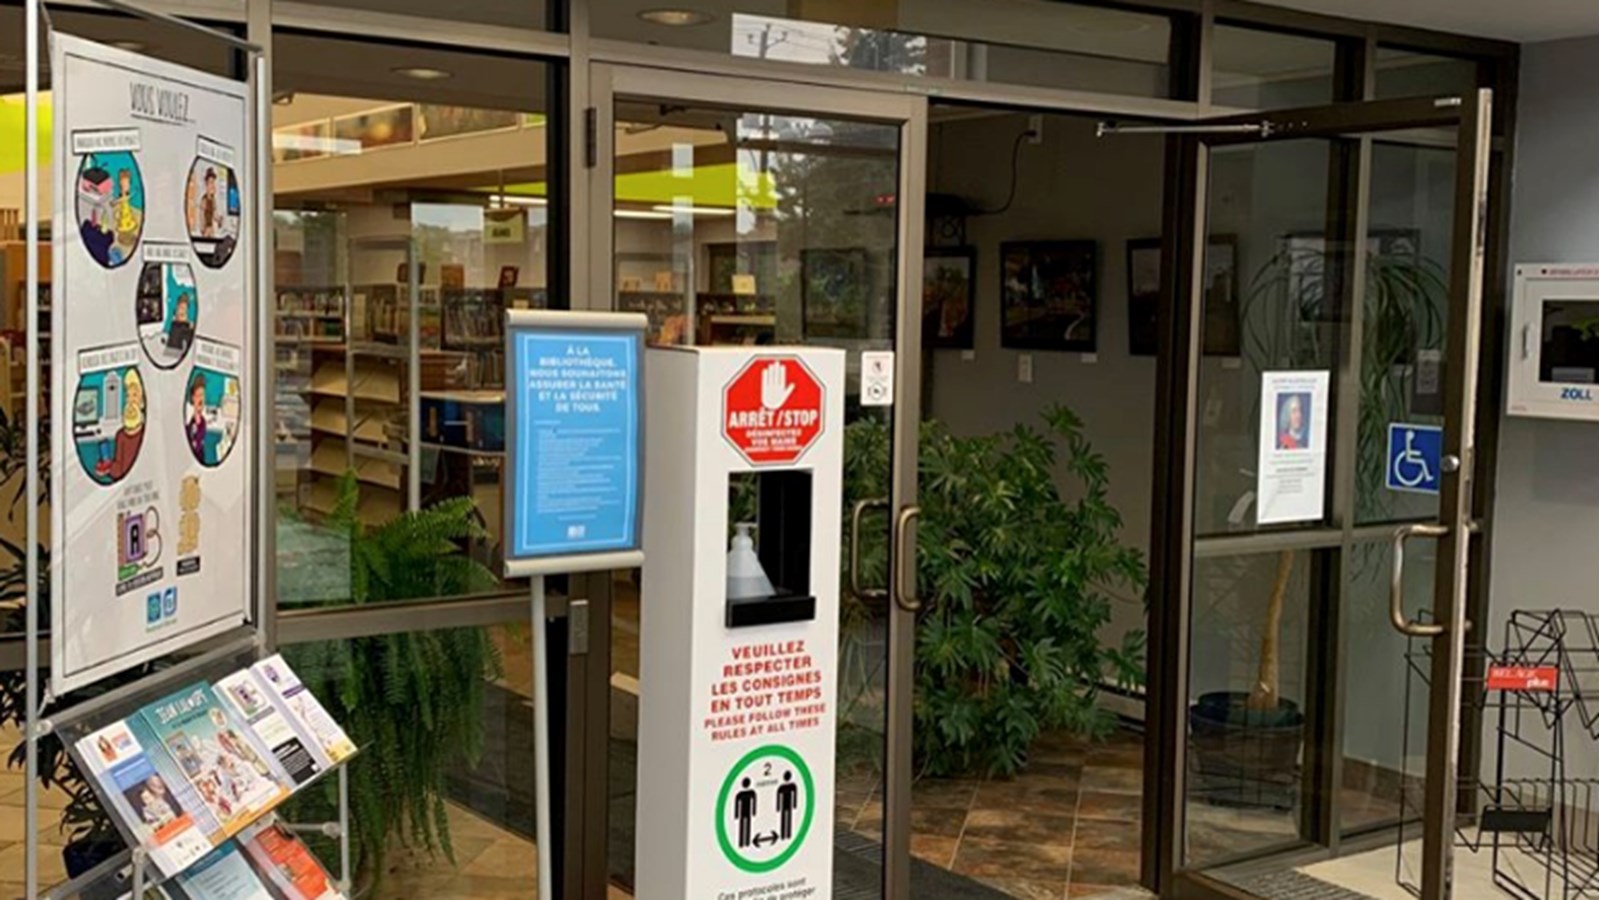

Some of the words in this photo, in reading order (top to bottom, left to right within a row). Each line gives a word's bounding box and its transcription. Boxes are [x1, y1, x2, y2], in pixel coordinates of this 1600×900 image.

[566, 344, 574, 355] À
[576, 346, 590, 355] LA
[530, 369, 559, 378] NOUS
[561, 369, 626, 379] SOUHAITONS
[529, 380, 576, 389] ASSURER
[579, 380, 592, 389] LA
[595, 379, 626, 390] SANTÉ
[538, 391, 551, 401] ET
[554, 391, 567, 401] LA
[570, 390, 617, 401] SÉCURITÉ
[1561, 387, 1593, 401] ZOLL
[555, 403, 569, 413] DE
[732, 640, 805, 659] VEUILLEZ
[723, 655, 812, 677] RESPECTER
[711, 681, 737, 696] LES
[742, 670, 821, 692] CONSIGNES
[711, 699, 730, 713] EN
[735, 694, 772, 709] TOUT
[778, 686, 821, 703] TEMPS
[704, 715, 745, 729] PLEASE
[748, 708, 791, 722] FOLLOW
[794, 703, 826, 716] THESE
[711, 728, 746, 741] RULES
[750, 725, 764, 735] AT
[767, 723, 785, 733] ALL
[789, 717, 819, 729] TIMES
[763, 761, 772, 776] 2
[738, 883, 785, 900] protocoles
[787, 877, 806, 889] sont
